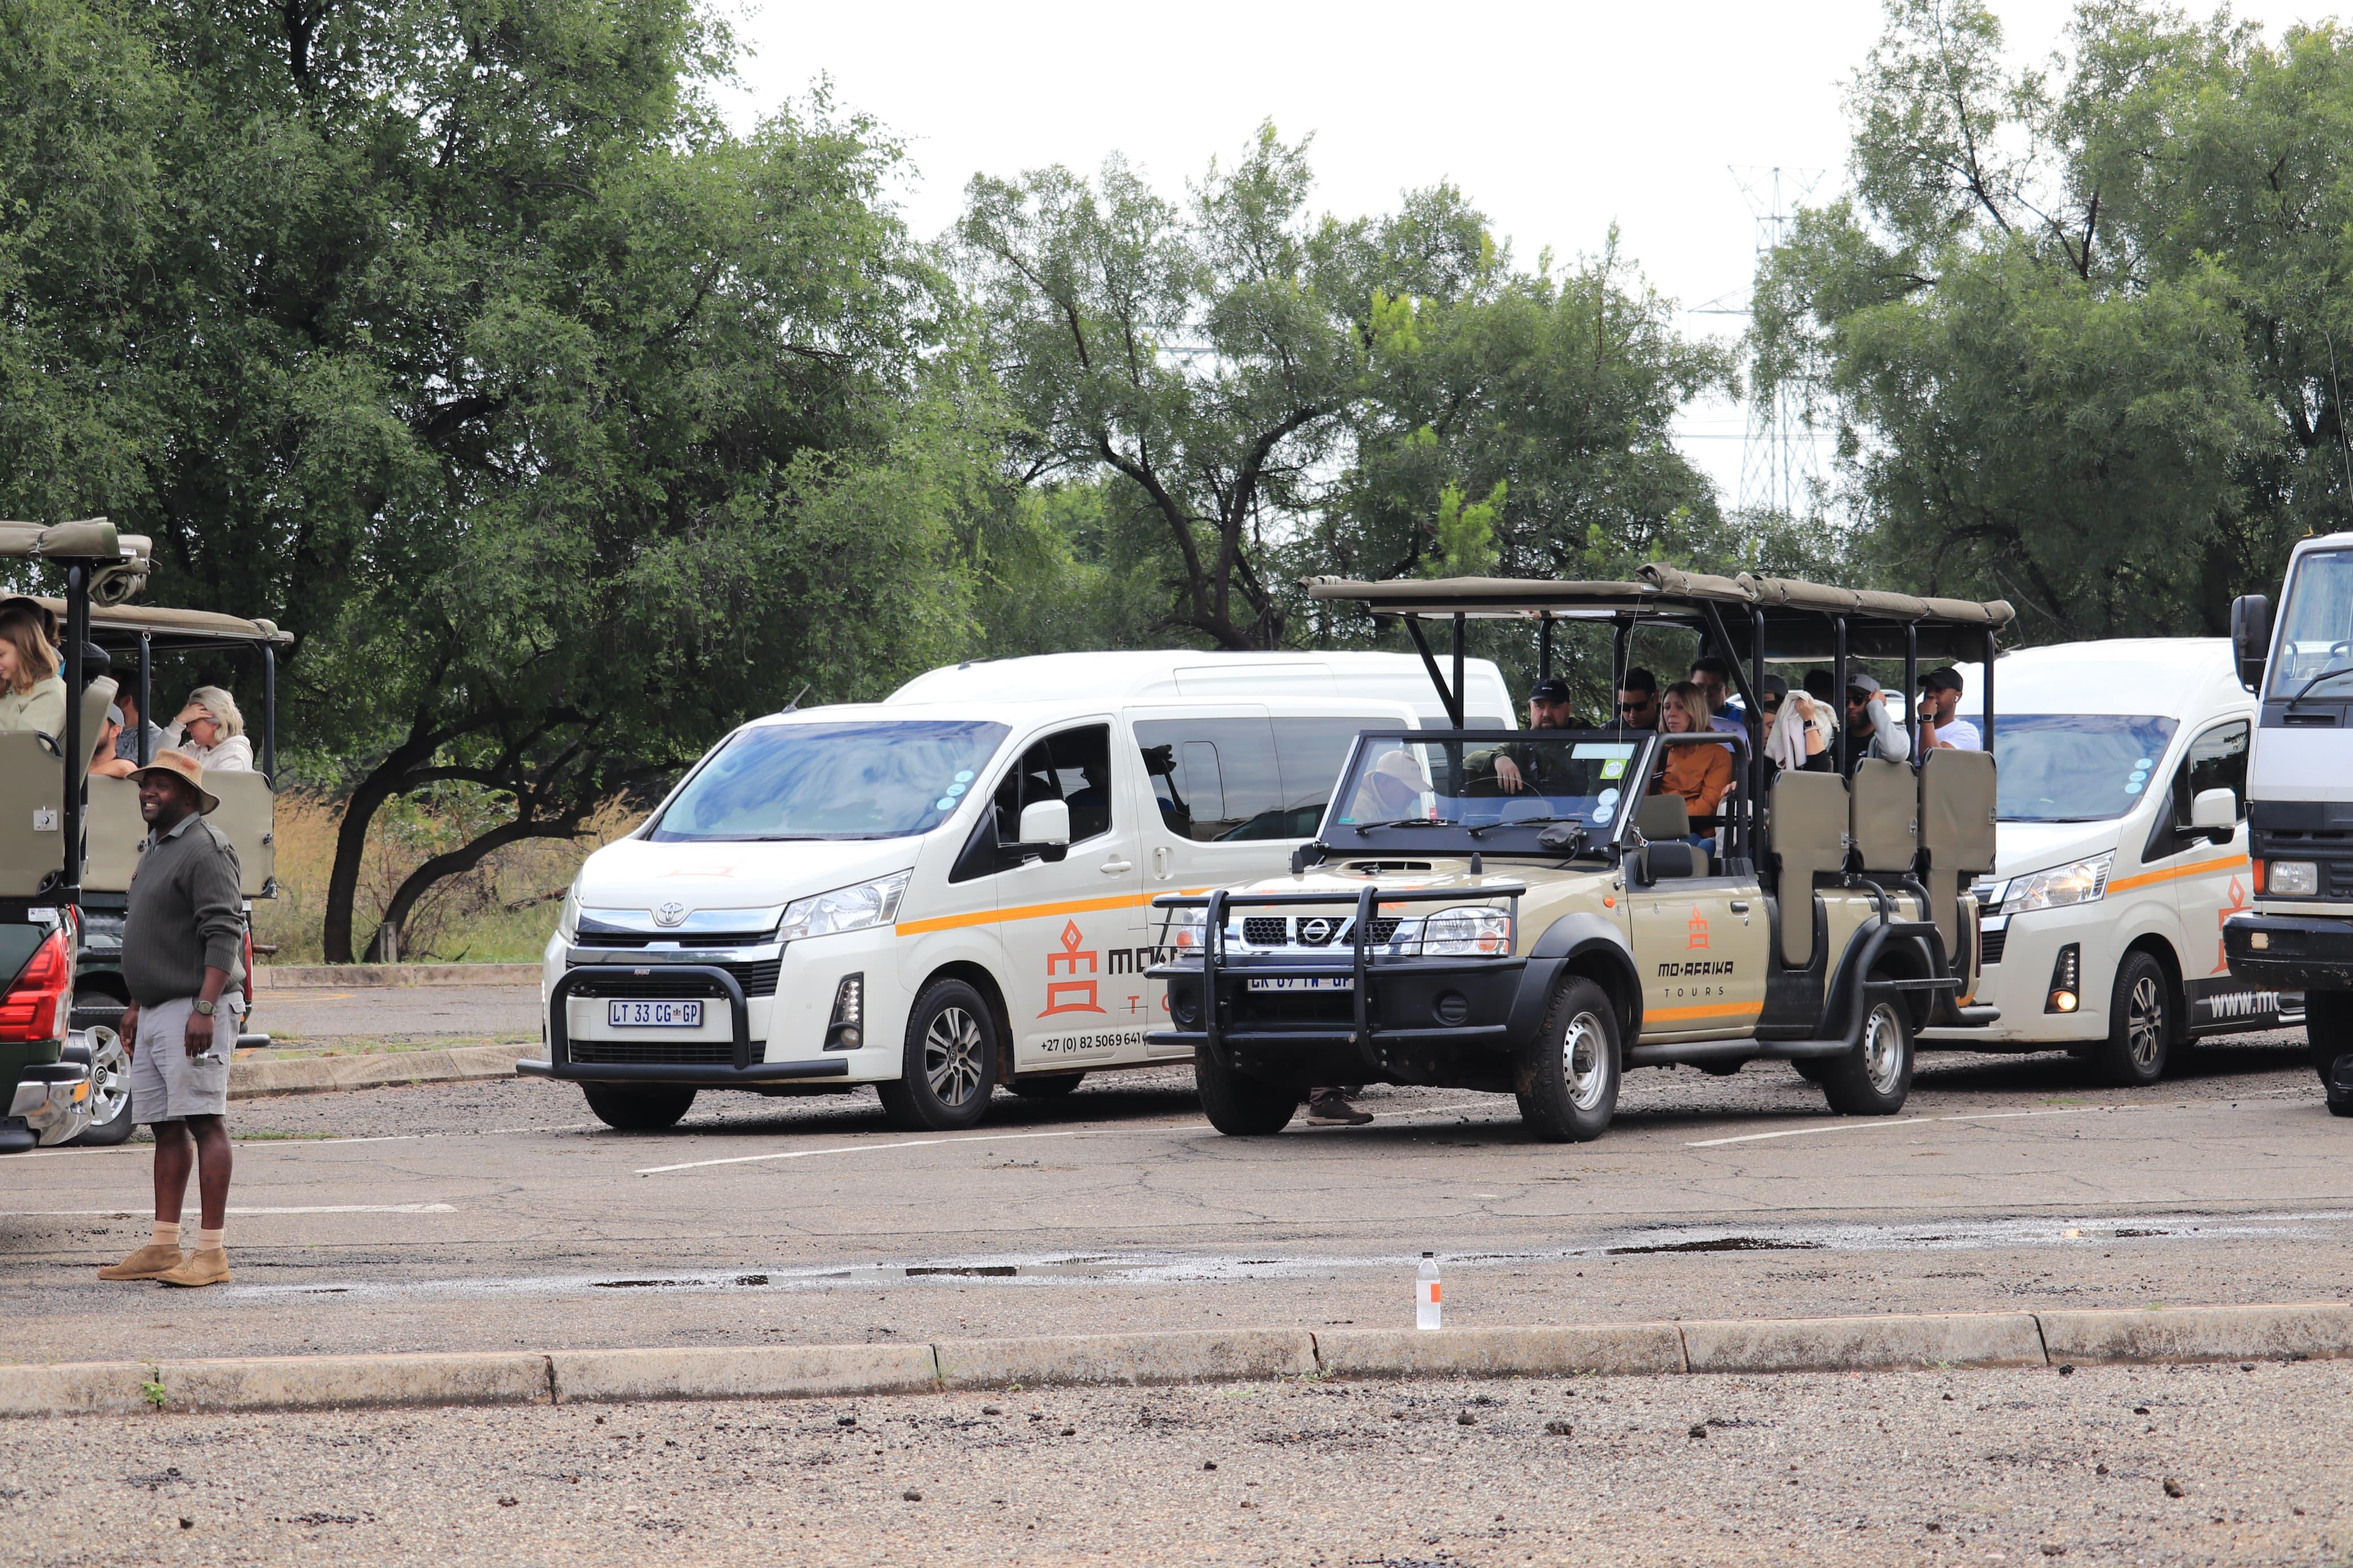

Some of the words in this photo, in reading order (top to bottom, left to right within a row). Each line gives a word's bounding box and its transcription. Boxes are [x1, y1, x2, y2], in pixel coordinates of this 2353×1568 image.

[1665, 987, 1723, 997] TOURS
[613, 1004, 628, 1022] LT
[635, 1004, 650, 1022] 33
[656, 1004, 671, 1022] CG
[683, 1005, 697, 1022] GP
[1041, 1039, 1059, 1052] +27
[1063, 1036, 1076, 1053] (0)
[1080, 1036, 1092, 1049] 82
